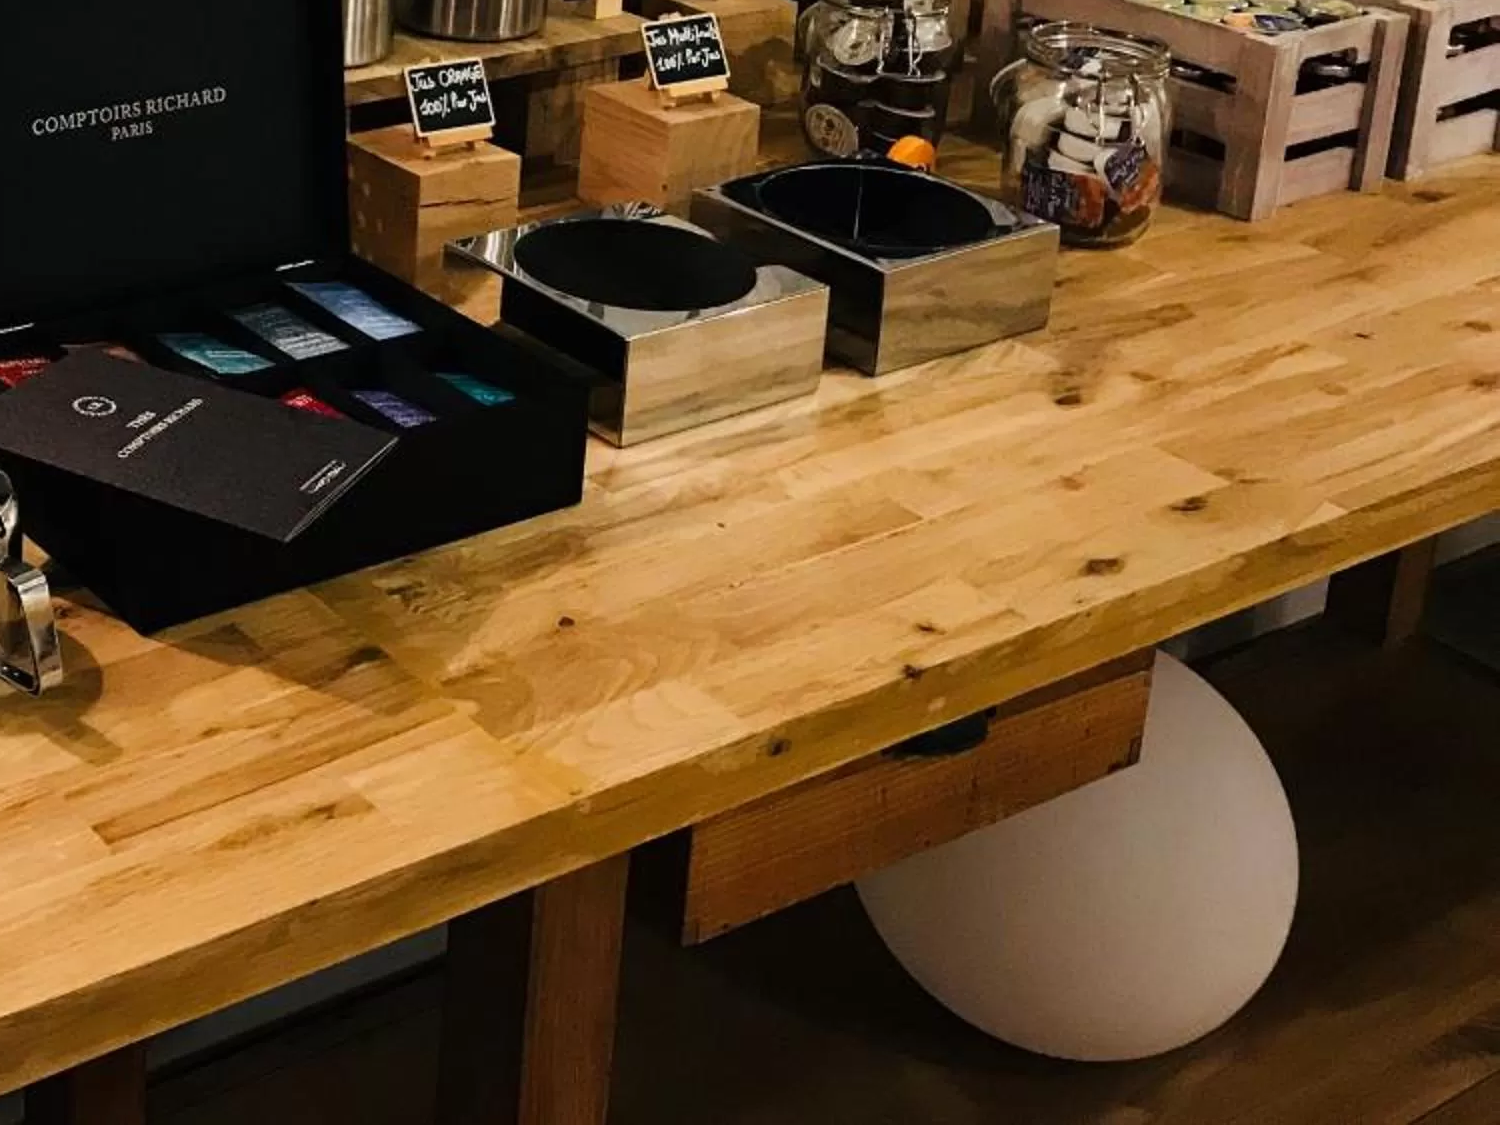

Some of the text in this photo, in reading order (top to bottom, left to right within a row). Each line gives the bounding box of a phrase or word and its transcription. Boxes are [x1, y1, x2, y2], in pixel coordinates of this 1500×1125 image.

[645, 29, 667, 48] Jus
[701, 46, 721, 68] Jus
[411, 71, 436, 92] Jus
[31, 86, 227, 136] COMPTOIRS RICHARD
[420, 92, 451, 120] 100%
[467, 89, 488, 113] Jus
[111, 120, 154, 142] PARIS
